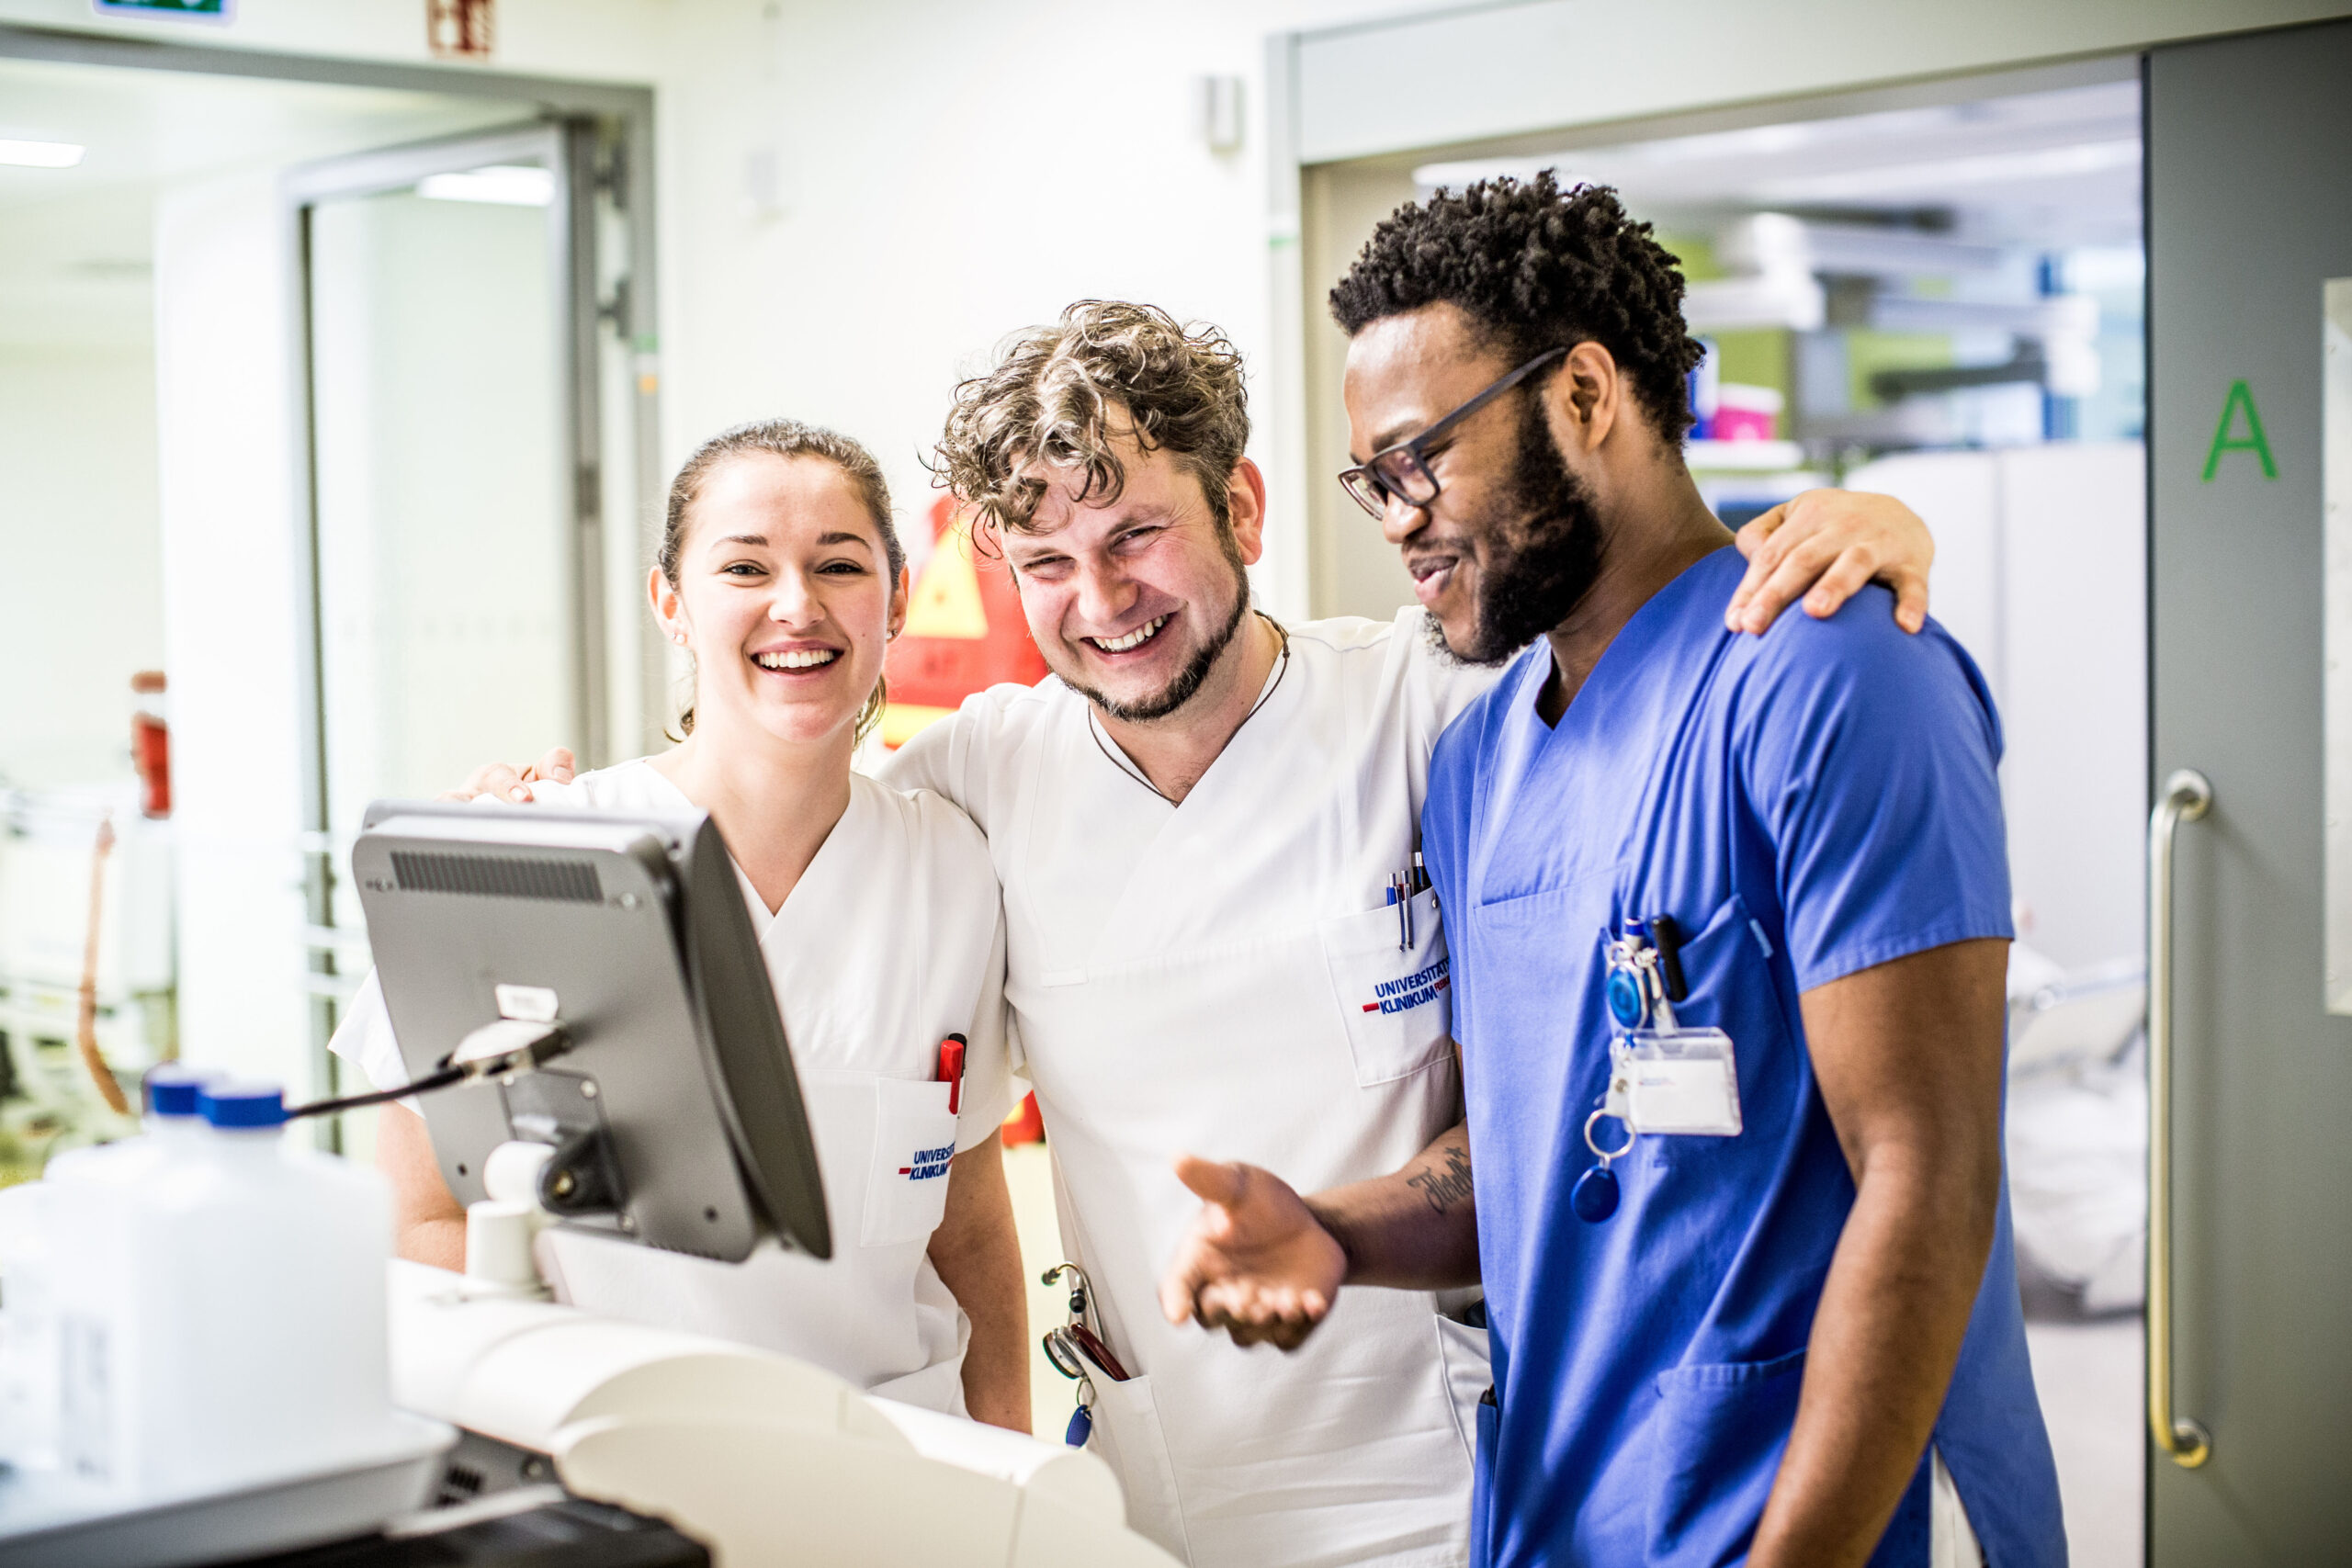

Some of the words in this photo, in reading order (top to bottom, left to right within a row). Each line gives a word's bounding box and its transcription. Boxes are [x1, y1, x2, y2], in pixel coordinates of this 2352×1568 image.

[2200, 378, 2278, 483] A
[1379, 985, 1438, 1015] KLINIKUM
[909, 1161, 949, 1180] KLINIKUM
